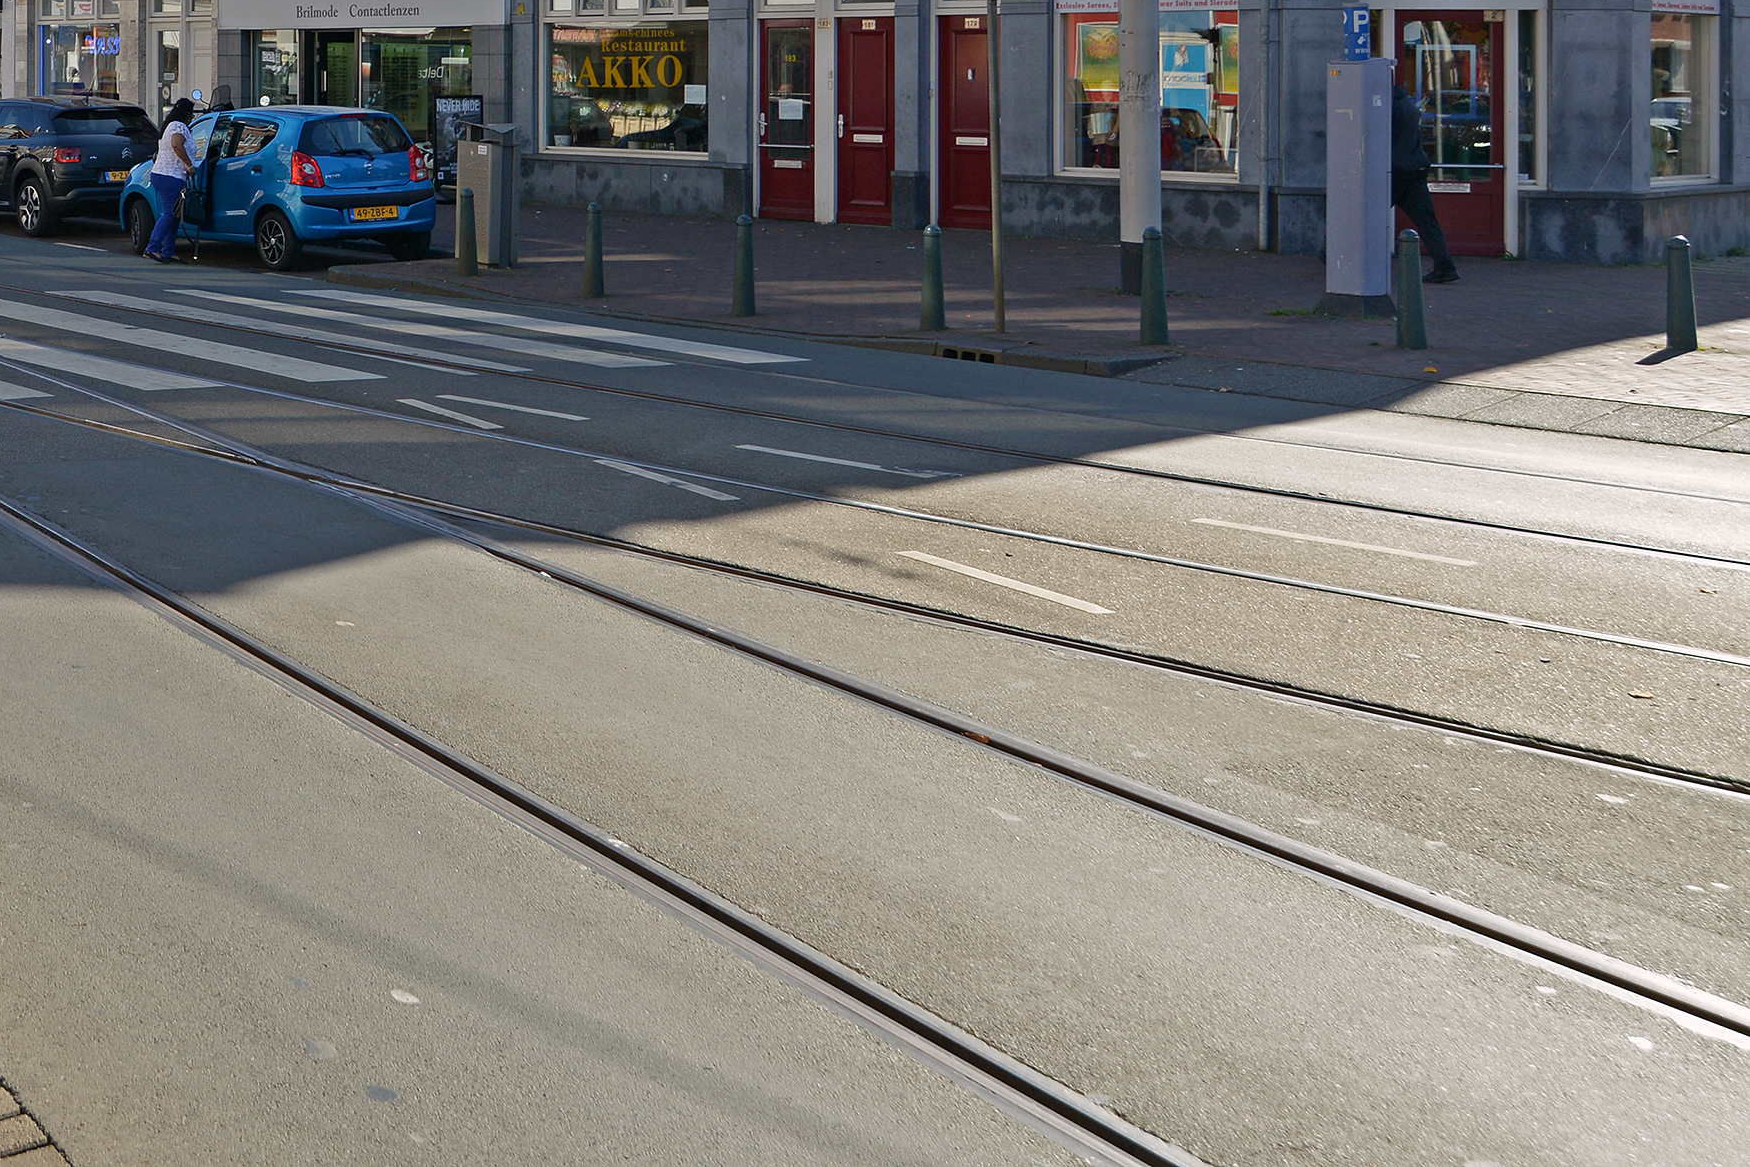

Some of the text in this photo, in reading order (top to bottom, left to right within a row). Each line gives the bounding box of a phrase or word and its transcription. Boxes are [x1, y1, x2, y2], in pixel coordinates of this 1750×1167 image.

[1087, 2, 1112, 10] Sarees,
[1210, 0, 1238, 7] Sierade
[296, 4, 420, 19] Brilmode Contactlenzen
[966, 19, 979, 27] 179
[1353, 10, 1369, 33] P
[600, 28, 676, 38] ams-chinees
[601, 38, 687, 53] Restaurant
[784, 54, 797, 63] 183
[574, 54, 684, 88] AKKO
[436, 98, 481, 112] NEVER HIDE
[356, 207, 394, 218] 49-ZBF-4
